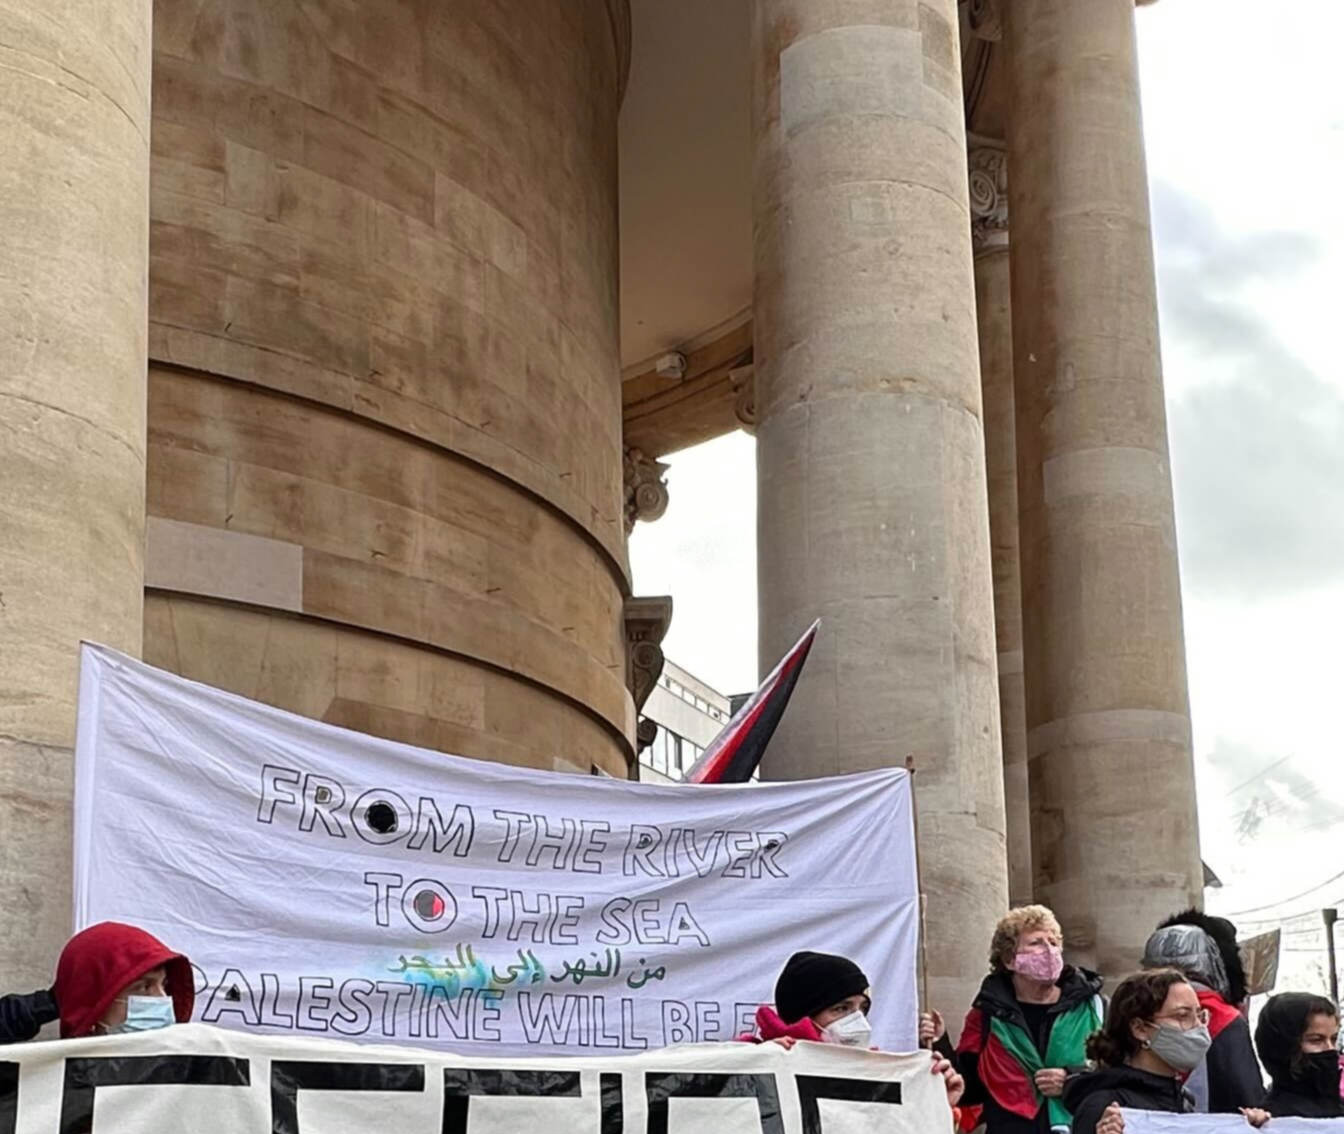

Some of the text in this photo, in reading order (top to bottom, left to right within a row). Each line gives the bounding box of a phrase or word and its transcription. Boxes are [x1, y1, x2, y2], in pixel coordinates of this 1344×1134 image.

[256, 764, 790, 880] FROM THE RIVER
[364, 871, 711, 947] TO THE SEA
[550, 947, 621, 985] النهر
[627, 957, 666, 989] من
[517, 991, 648, 1049] WILL
[661, 1000, 720, 1047] BE
